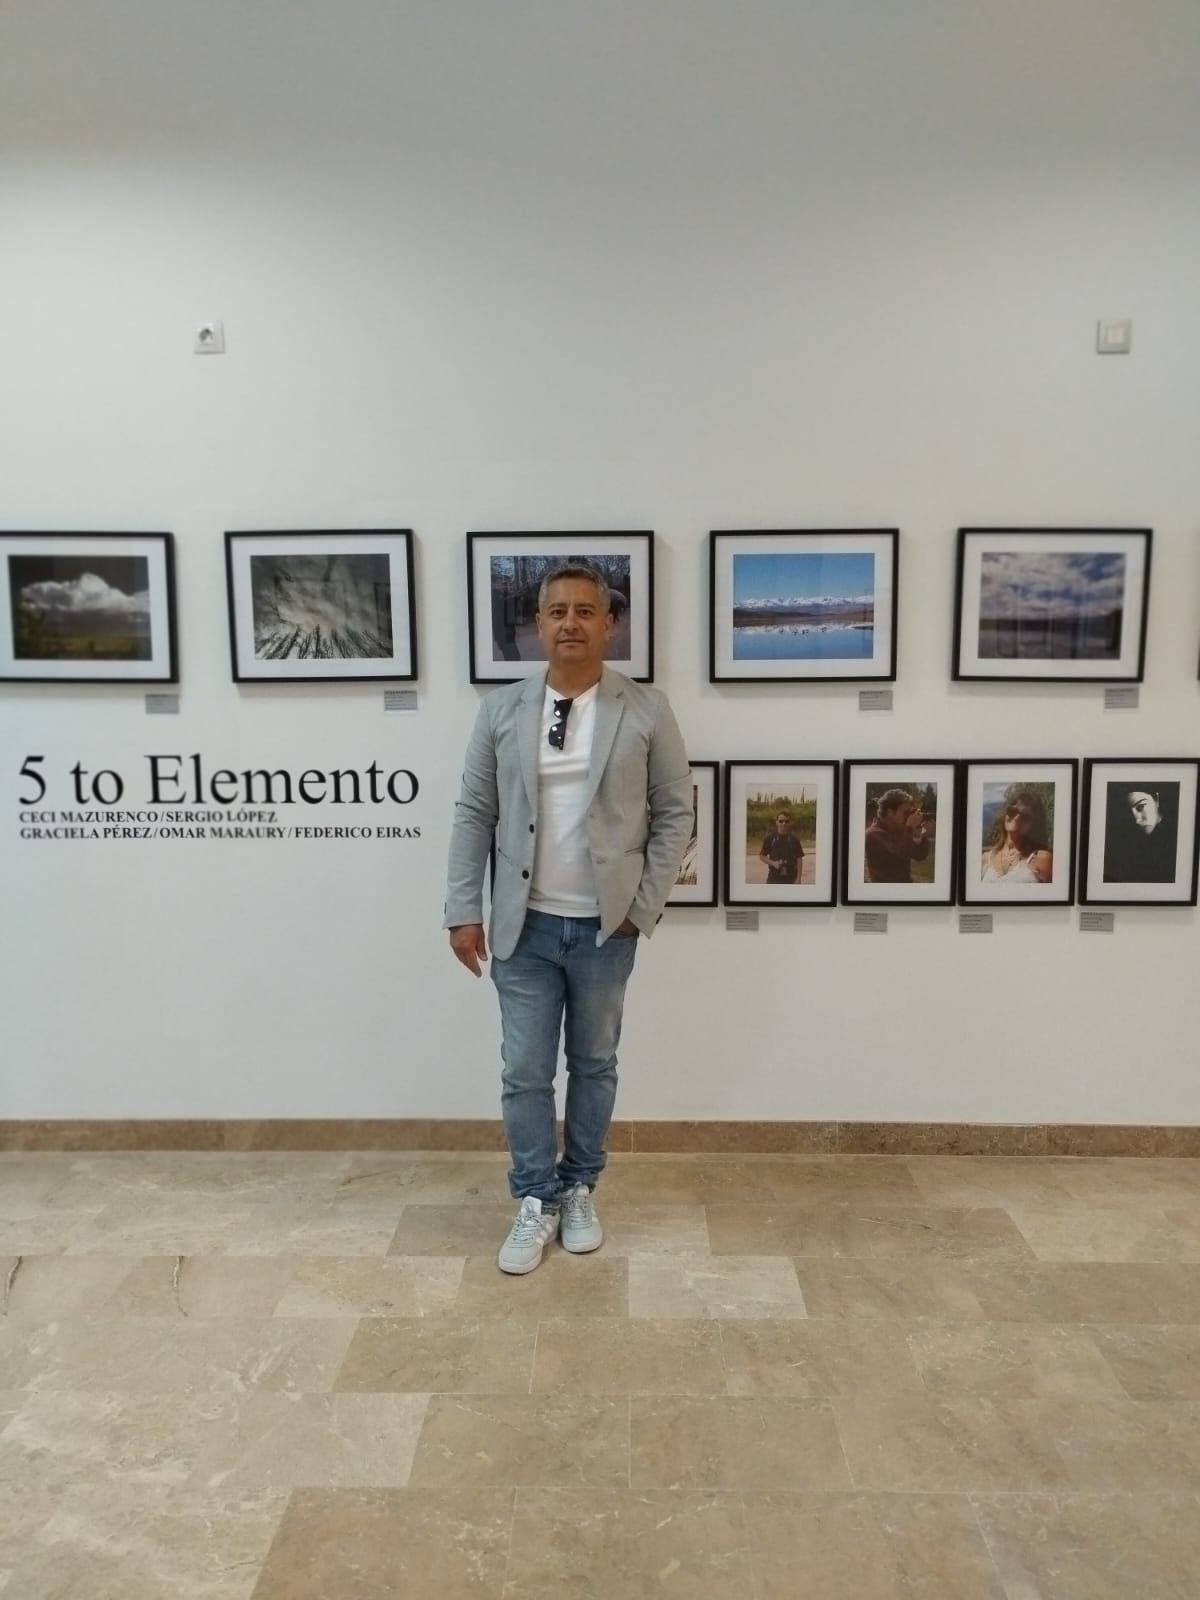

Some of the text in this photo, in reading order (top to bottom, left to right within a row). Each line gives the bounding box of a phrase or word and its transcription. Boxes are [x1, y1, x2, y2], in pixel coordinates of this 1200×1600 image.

[18, 752, 419, 805] 5 to Elemento
[19, 811, 56, 823] CECI
[226, 808, 278, 823] LÓPEZ
[20, 827, 99, 839] GRACIELA
[376, 826, 421, 839] EIRAS
